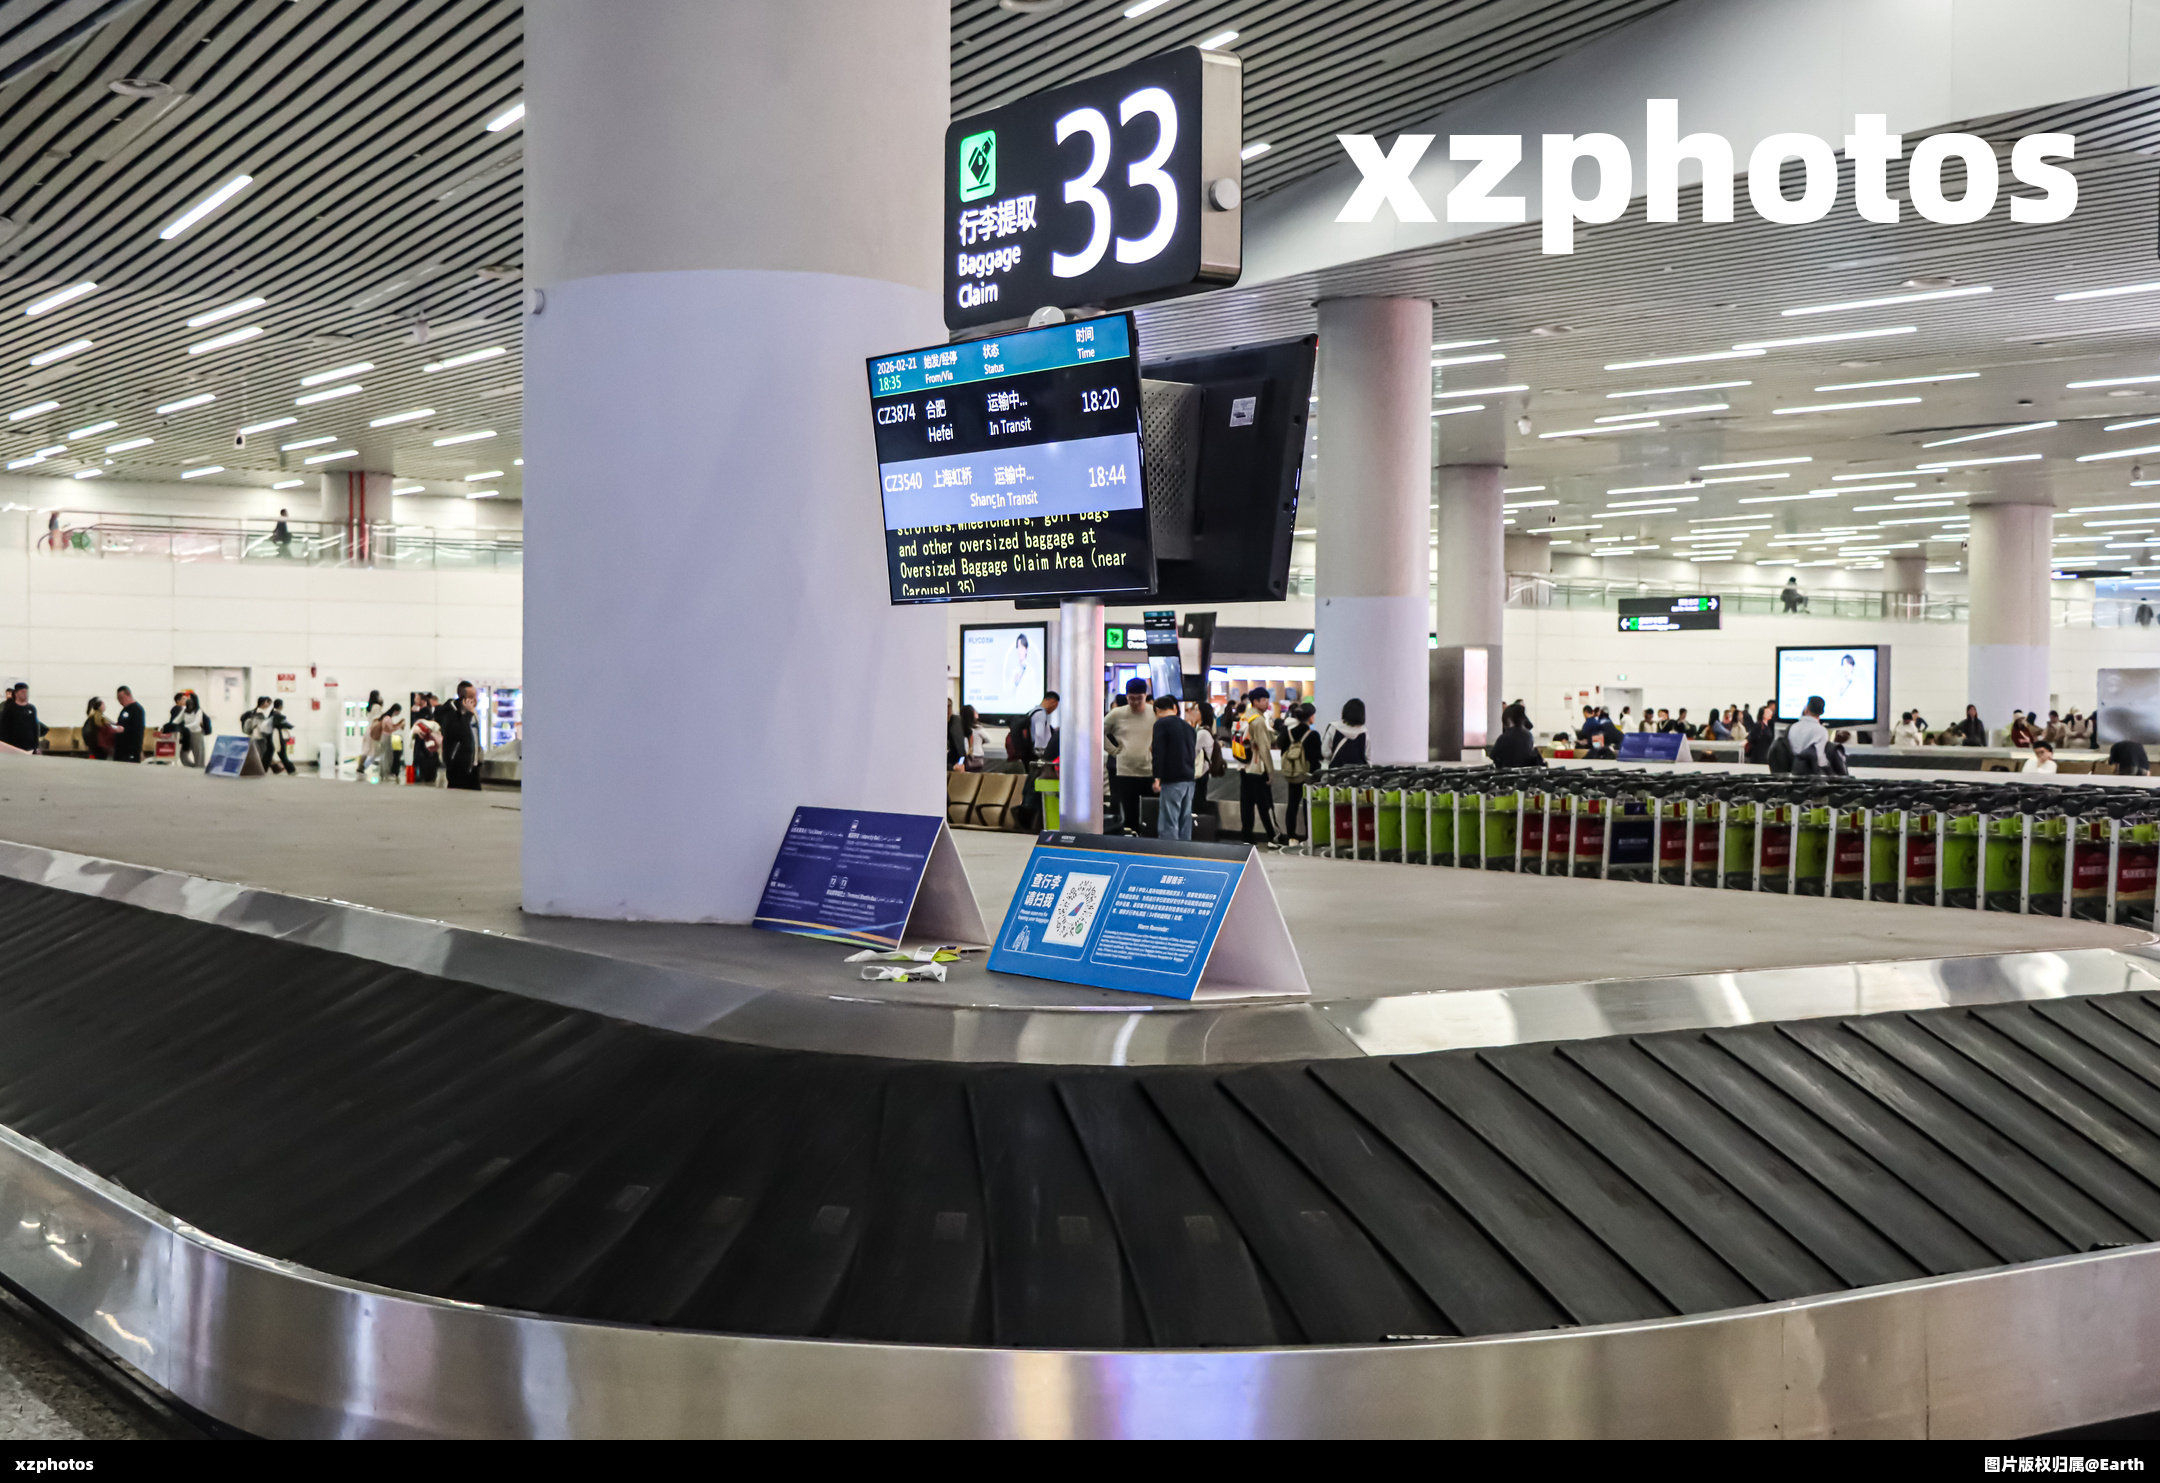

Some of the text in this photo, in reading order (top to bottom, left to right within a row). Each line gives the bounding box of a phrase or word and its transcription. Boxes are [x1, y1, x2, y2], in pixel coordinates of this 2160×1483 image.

[1051, 86, 1179, 279] 33
[958, 194, 1037, 246] 行李提取
[958, 245, 1021, 277] Baggage
[958, 283, 998, 309] Claim
[877, 326, 1095, 376] 2026-02-21 始发/经停 状态 时间
[878, 348, 1095, 392] 18:35 From/Via Status Time
[877, 403, 917, 425] CZ3874
[925, 399, 947, 420] 合肥
[1081, 387, 1120, 413] 18:20
[928, 417, 1032, 443] Hefei In Transit
[884, 471, 923, 492] CZ3540
[933, 466, 973, 489] 上海虹桥
[1088, 464, 1127, 488] 18:44
[996, 493, 1006, 507] In
[1007, 490, 1039, 506] Transit
[899, 527, 1097, 558] and other oversized baggage at
[900, 547, 1127, 579] Oversized Baggage Claim Area (near
[1031, 873, 1062, 890] 查行李
[1024, 890, 1055, 909] 请扫我
